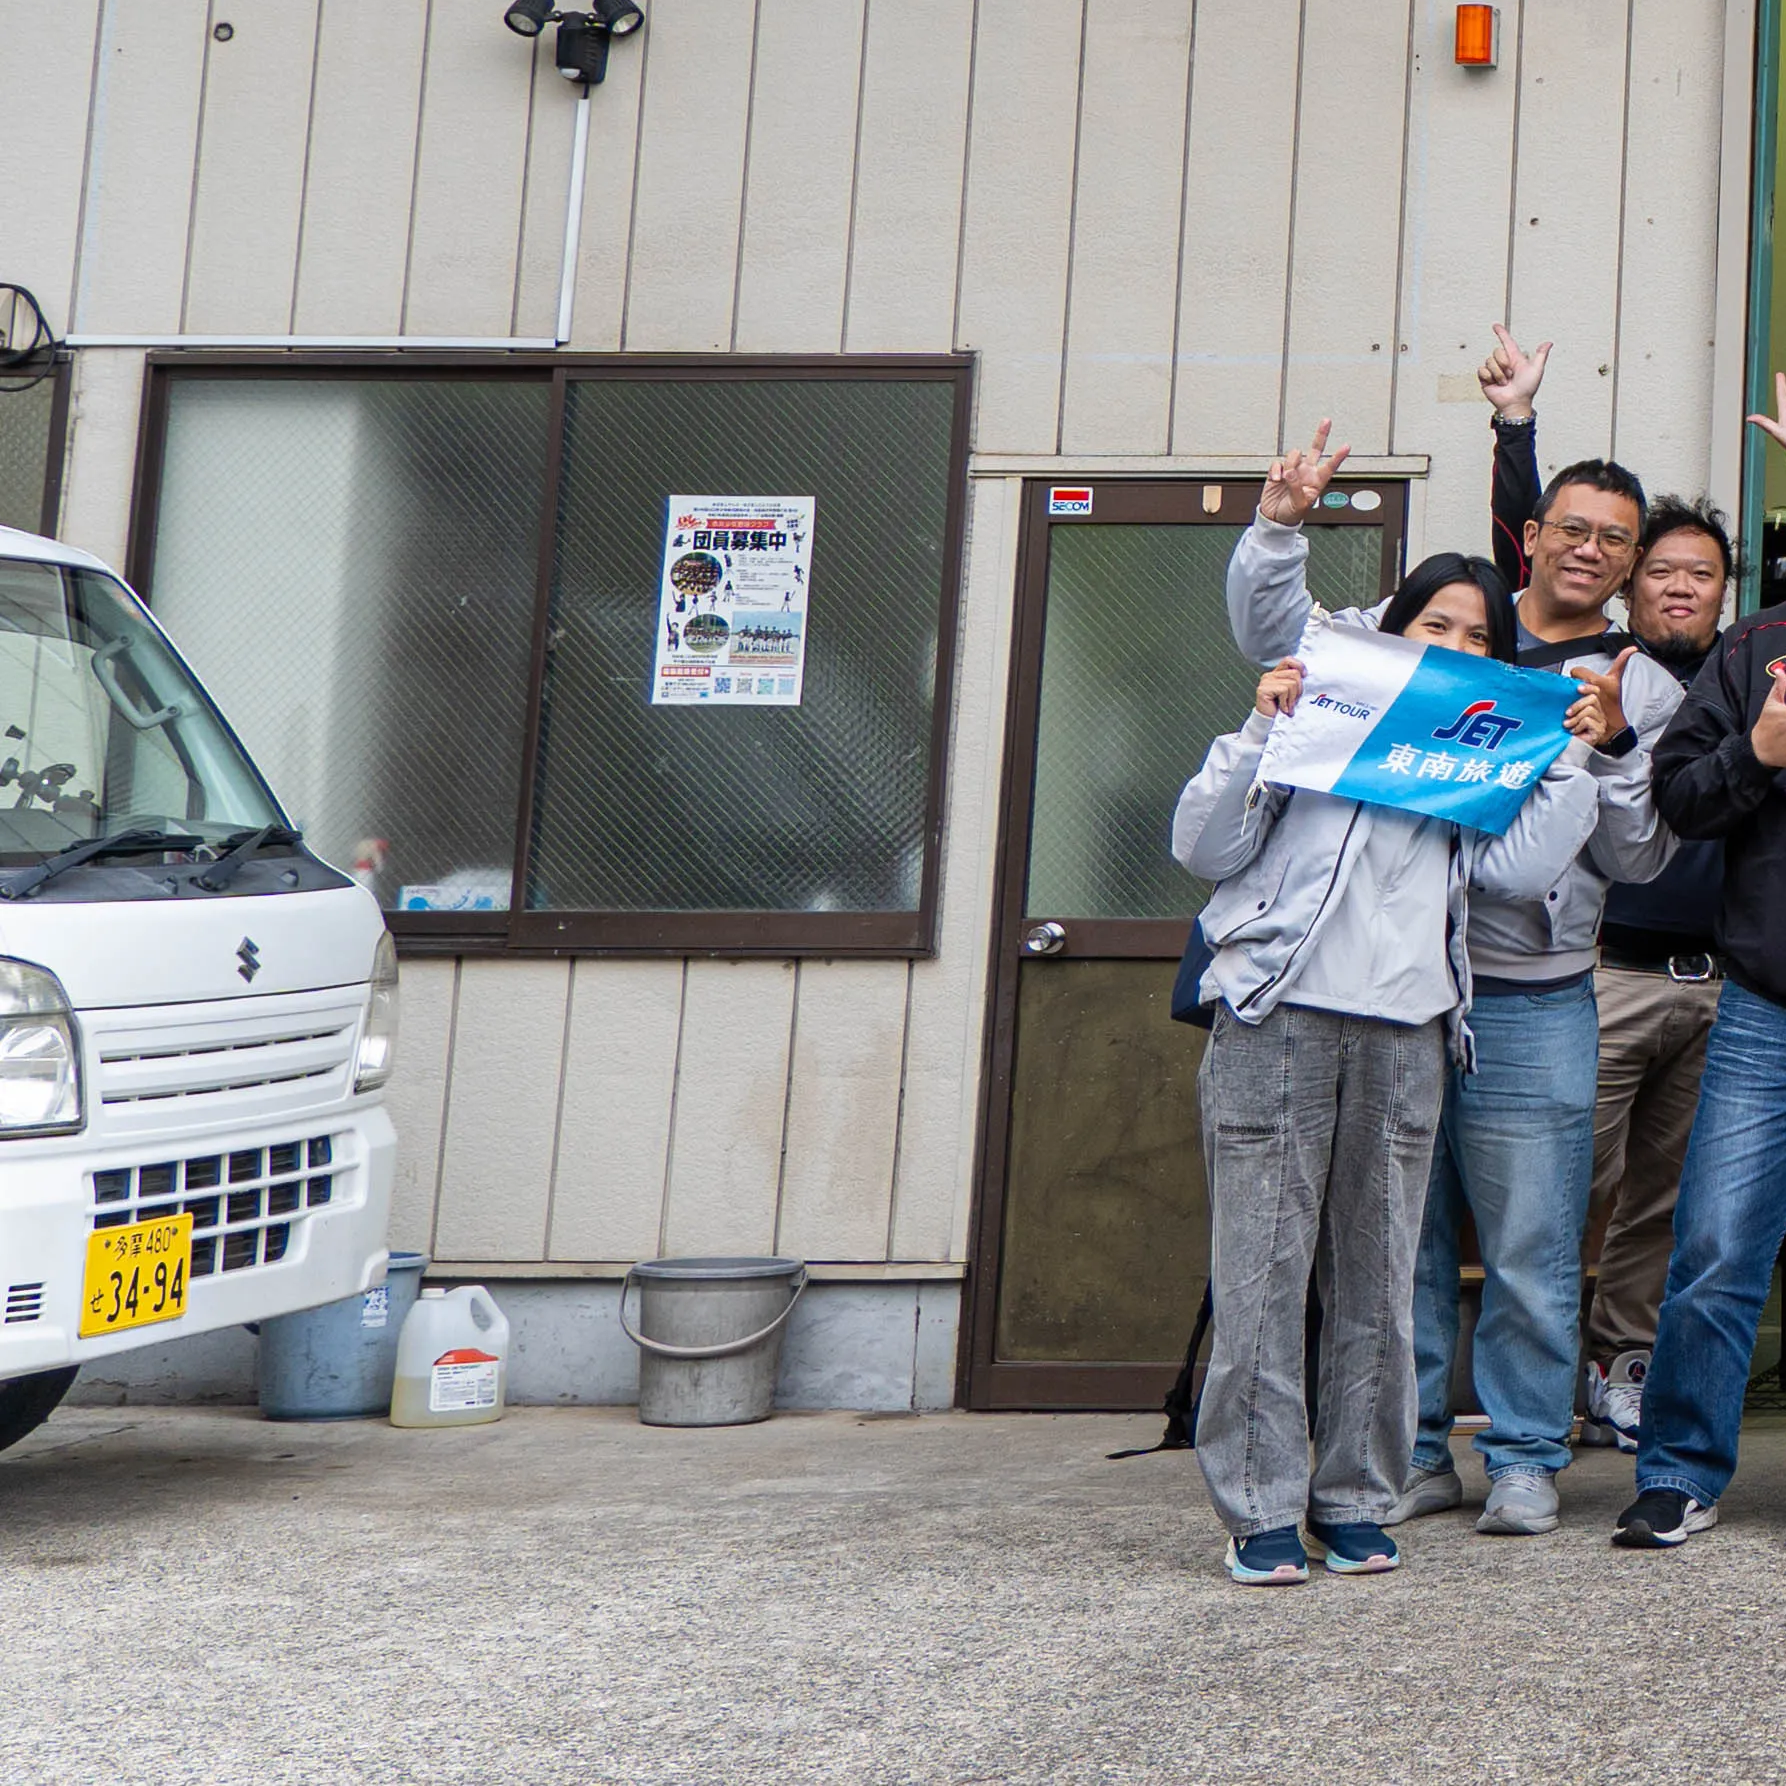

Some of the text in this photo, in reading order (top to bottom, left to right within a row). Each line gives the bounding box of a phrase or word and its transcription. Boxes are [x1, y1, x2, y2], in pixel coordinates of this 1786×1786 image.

[1052, 501, 1090, 511] SECOM
[693, 530, 788, 552] 団員募集中
[1378, 743, 1537, 790] 東南旅遊
[106, 1257, 184, 1323] 34-94
